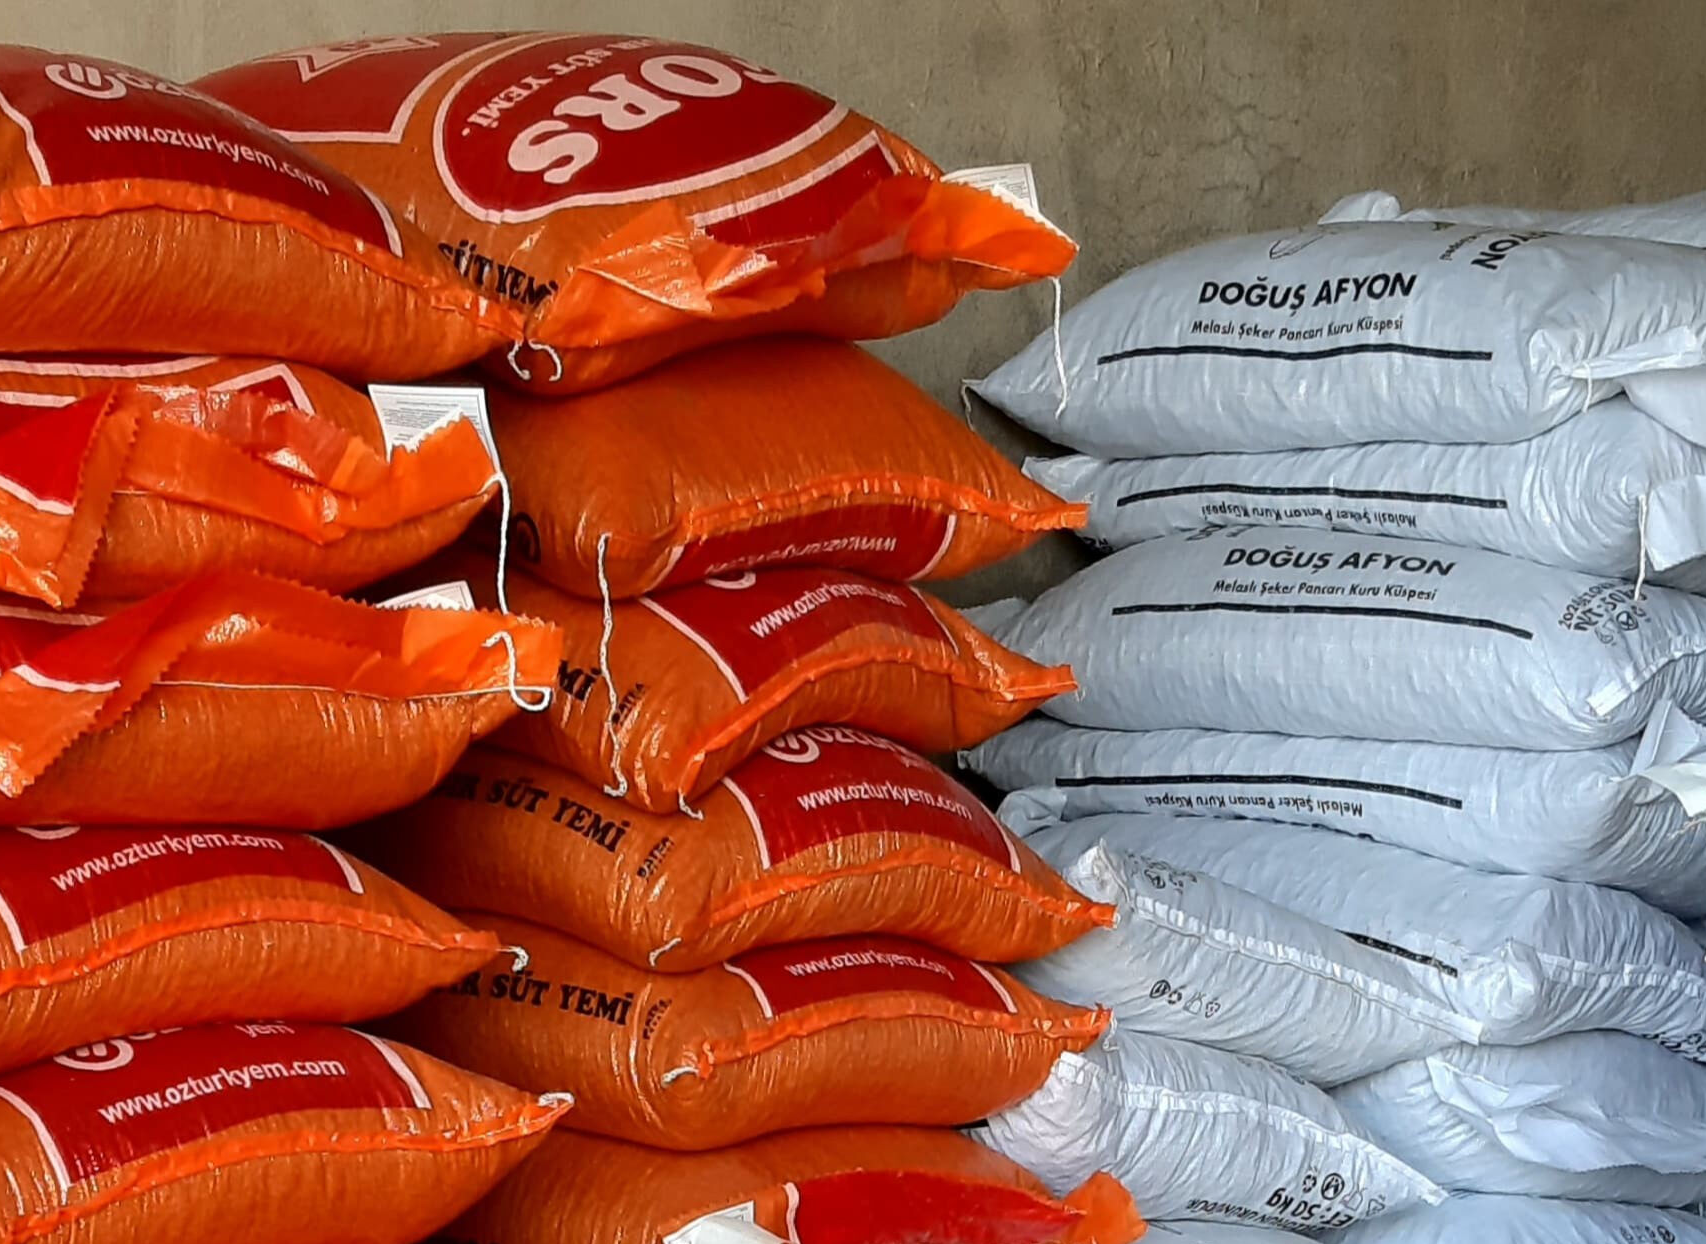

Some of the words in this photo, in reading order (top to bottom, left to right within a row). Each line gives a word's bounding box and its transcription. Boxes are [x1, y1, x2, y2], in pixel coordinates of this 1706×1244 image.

[86, 122, 331, 196] www.ozturkyem.com
[1199, 275, 1306, 317] DOĞUŞ
[1313, 272, 1417, 307] AFYON
[1191, 319, 1235, 337] Melaslı
[1238, 322, 1275, 340] Şeker
[1213, 579, 1257, 595] Melaslı
[1260, 580, 1296, 597] Şeker
[1298, 581, 1345, 597] Pancarı
[1349, 582, 1380, 597] Kuru
[1383, 584, 1438, 602] Küspesi
[1224, 544, 1334, 576] DOĞUŞ
[1337, 551, 1456, 577] AFYON
[484, 776, 551, 813] SÜT
[552, 798, 631, 854] YEMİ
[49, 830, 284, 893] www.ozturkyem.com
[488, 965, 552, 1007] SÜT
[559, 985, 635, 1027] YEMİ
[98, 1056, 347, 1127] www.ozturkyem.com
